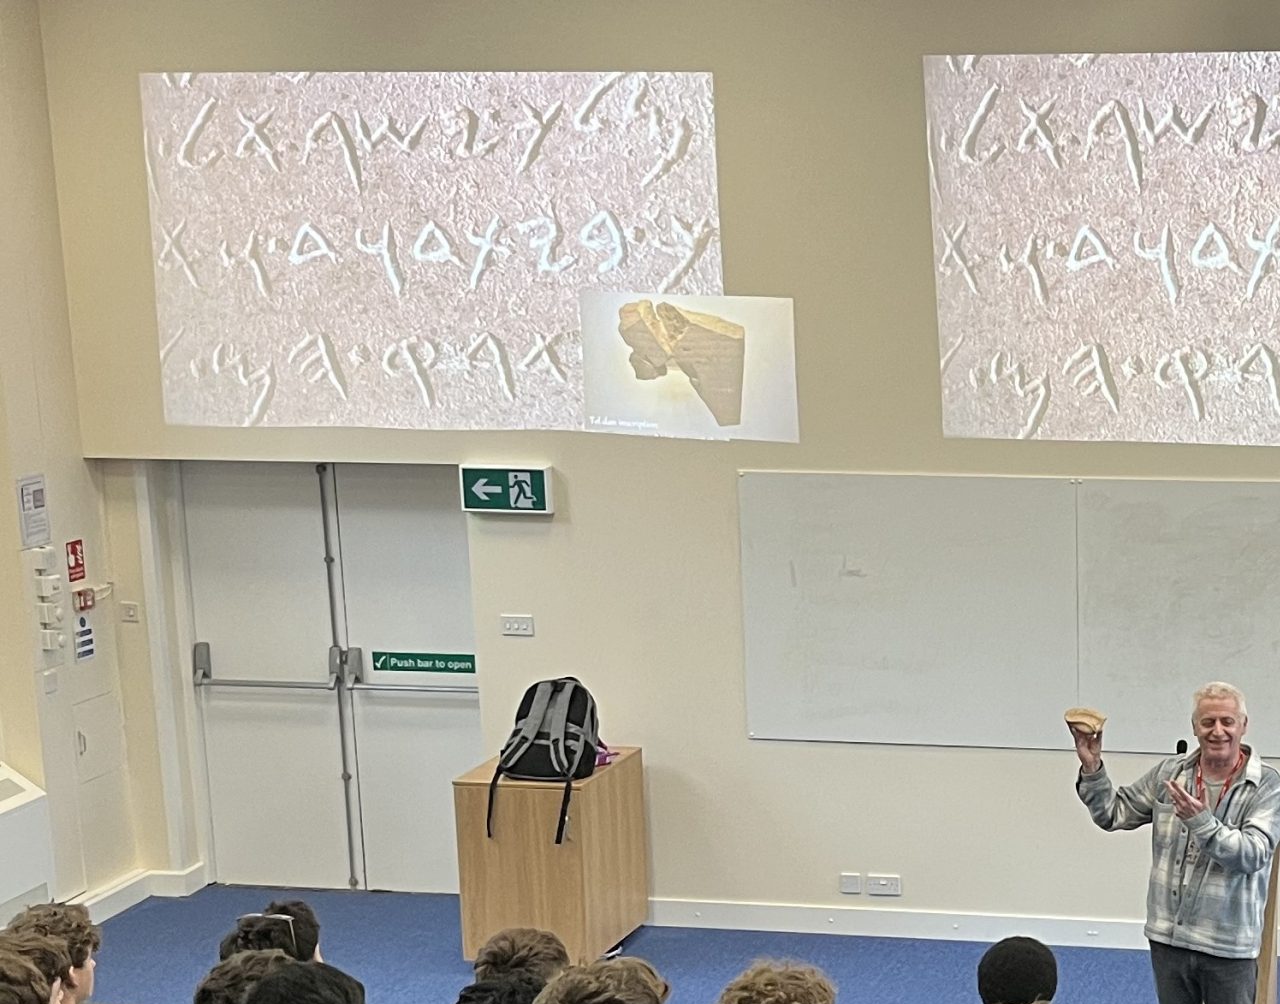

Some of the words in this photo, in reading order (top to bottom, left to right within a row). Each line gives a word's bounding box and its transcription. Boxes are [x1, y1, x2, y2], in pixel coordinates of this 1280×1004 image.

[390, 658, 415, 668] Push
[417, 659, 433, 668] bar
[435, 659, 445, 669] to
[447, 661, 472, 670] open
